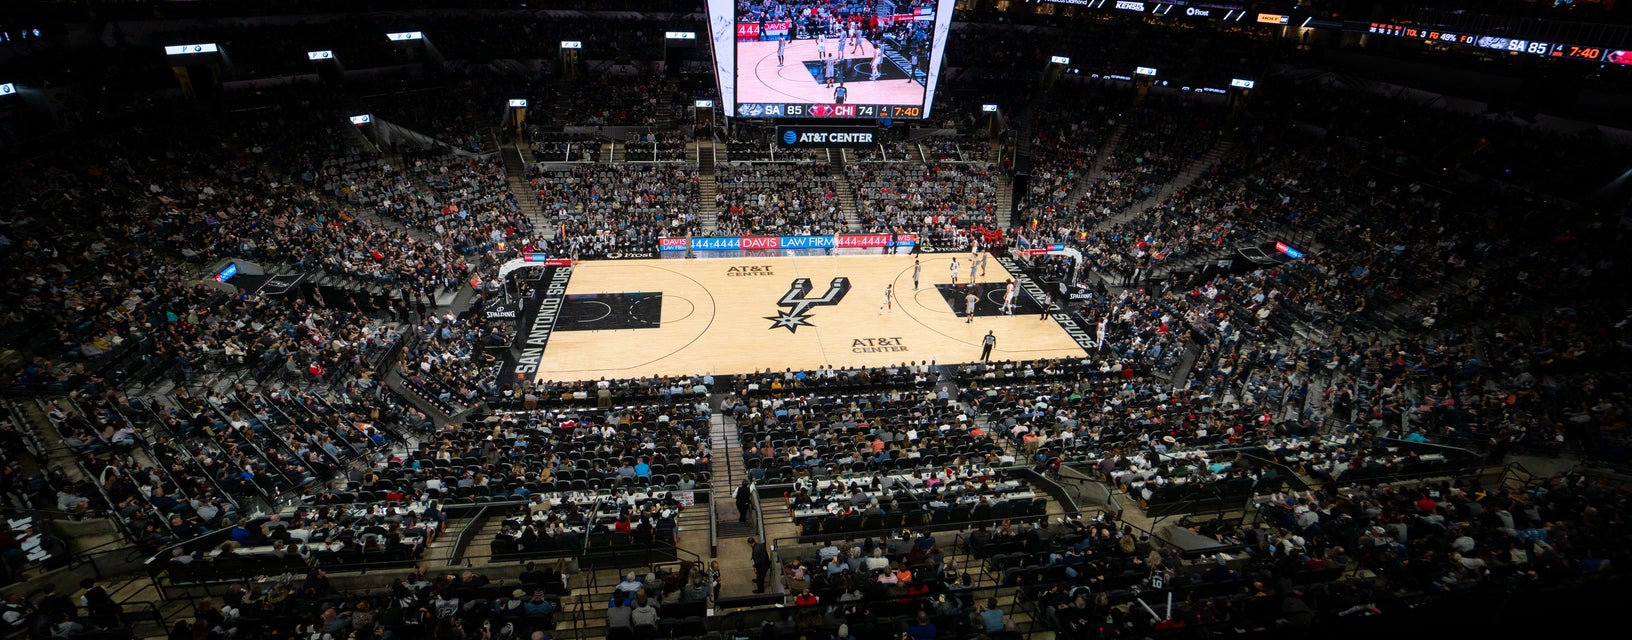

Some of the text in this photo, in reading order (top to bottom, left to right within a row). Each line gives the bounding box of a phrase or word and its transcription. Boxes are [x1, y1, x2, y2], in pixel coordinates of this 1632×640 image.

[1194, 9, 1209, 17] Frost
[764, 22, 787, 31] DAVIS
[1406, 29, 1418, 37] TOL
[1429, 31, 1440, 40] FG
[1440, 33, 1457, 42] 49%
[1460, 35, 1466, 43] F
[1466, 36, 1473, 44] 0
[1508, 39, 1525, 51] SA
[1528, 42, 1548, 54] 85
[1569, 46, 1600, 59] 7:40
[765, 105, 780, 115] SA
[787, 105, 802, 115] 85
[835, 106, 853, 116] CHI
[859, 106, 873, 116] 74
[894, 107, 919, 117] 7:40
[800, 133, 873, 143] AT&T CENTER
[663, 238, 686, 246] DAVIS
[742, 237, 777, 249] DAVIS
[781, 237, 806, 247] LAW
[809, 236, 834, 247] FIRM
[838, 235, 887, 246] 444-4444
[547, 266, 573, 295] SPURS
[1069, 292, 1093, 300] SPALDING
[997, 256, 1098, 349] SAN ANTONO SPURS
[486, 310, 516, 318] SPALDING
[526, 297, 561, 345] ANTONIO
[852, 337, 903, 347] AT&T
[515, 348, 543, 374] SAN
